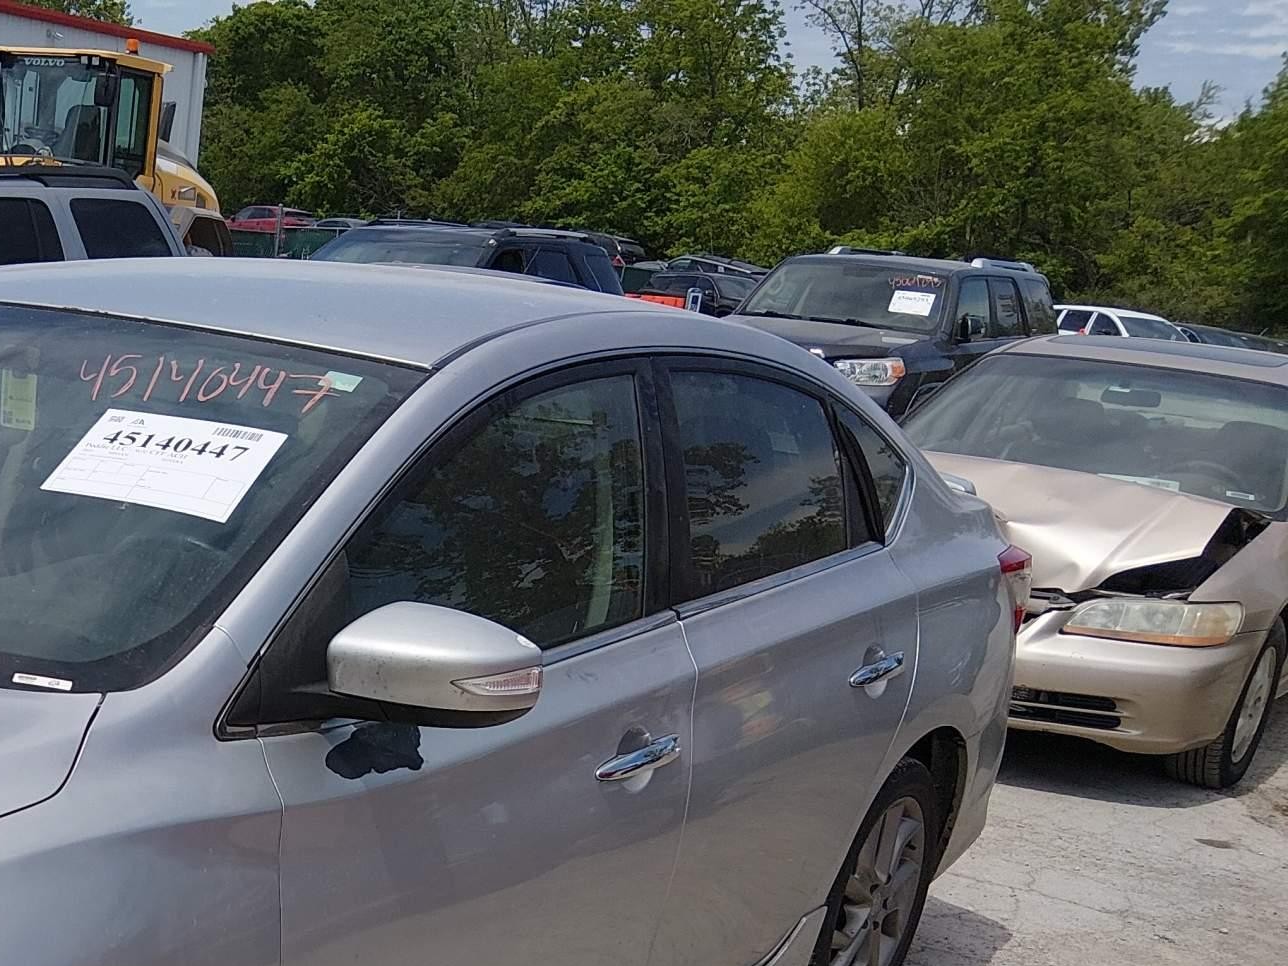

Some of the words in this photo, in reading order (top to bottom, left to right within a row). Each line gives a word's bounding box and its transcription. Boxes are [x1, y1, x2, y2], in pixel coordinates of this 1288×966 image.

[24, 57, 65, 67] VOLVO
[79, 354, 342, 415] 45140447
[103, 430, 251, 462] 45140447
